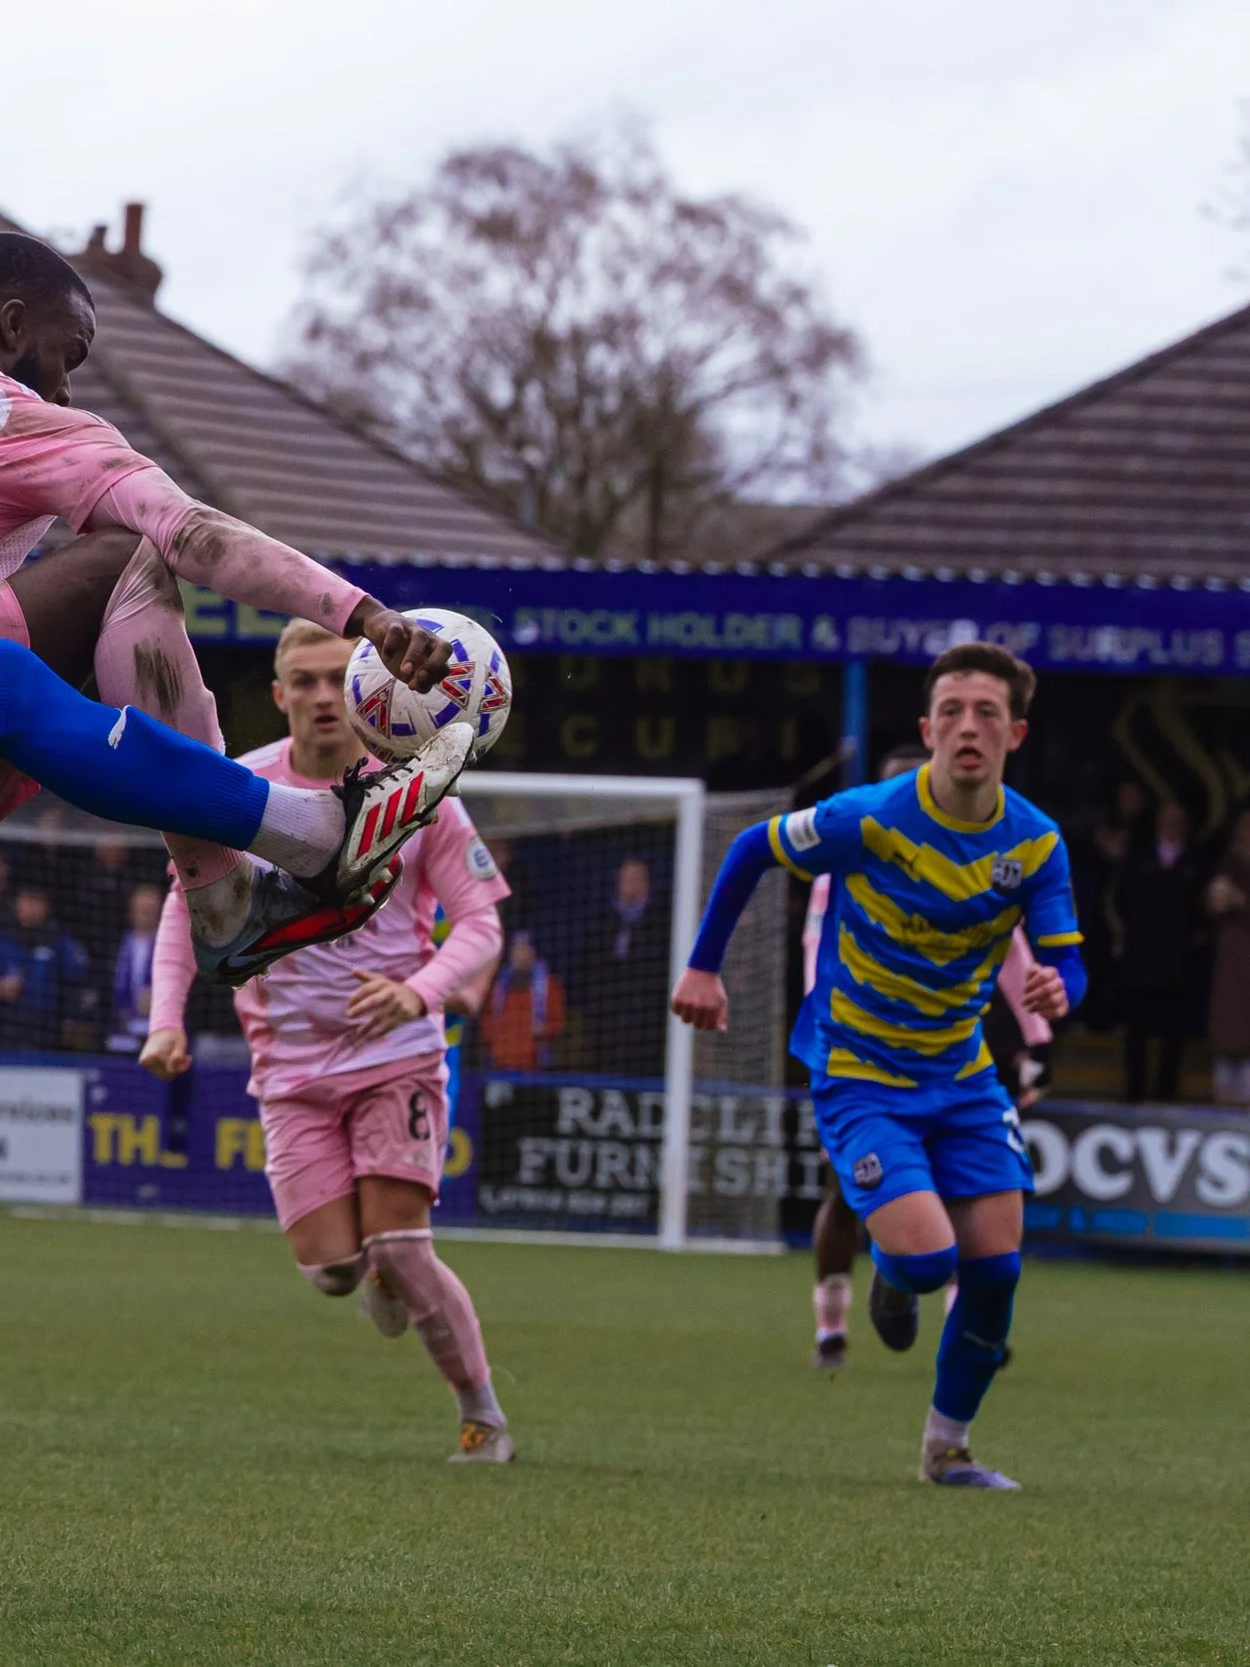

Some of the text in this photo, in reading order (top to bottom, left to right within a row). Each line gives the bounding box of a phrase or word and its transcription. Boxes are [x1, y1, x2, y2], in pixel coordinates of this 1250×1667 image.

[513, 606, 640, 645] STOCK
[647, 611, 801, 650] HOLDER
[1050, 623, 1224, 666] SURPLUS
